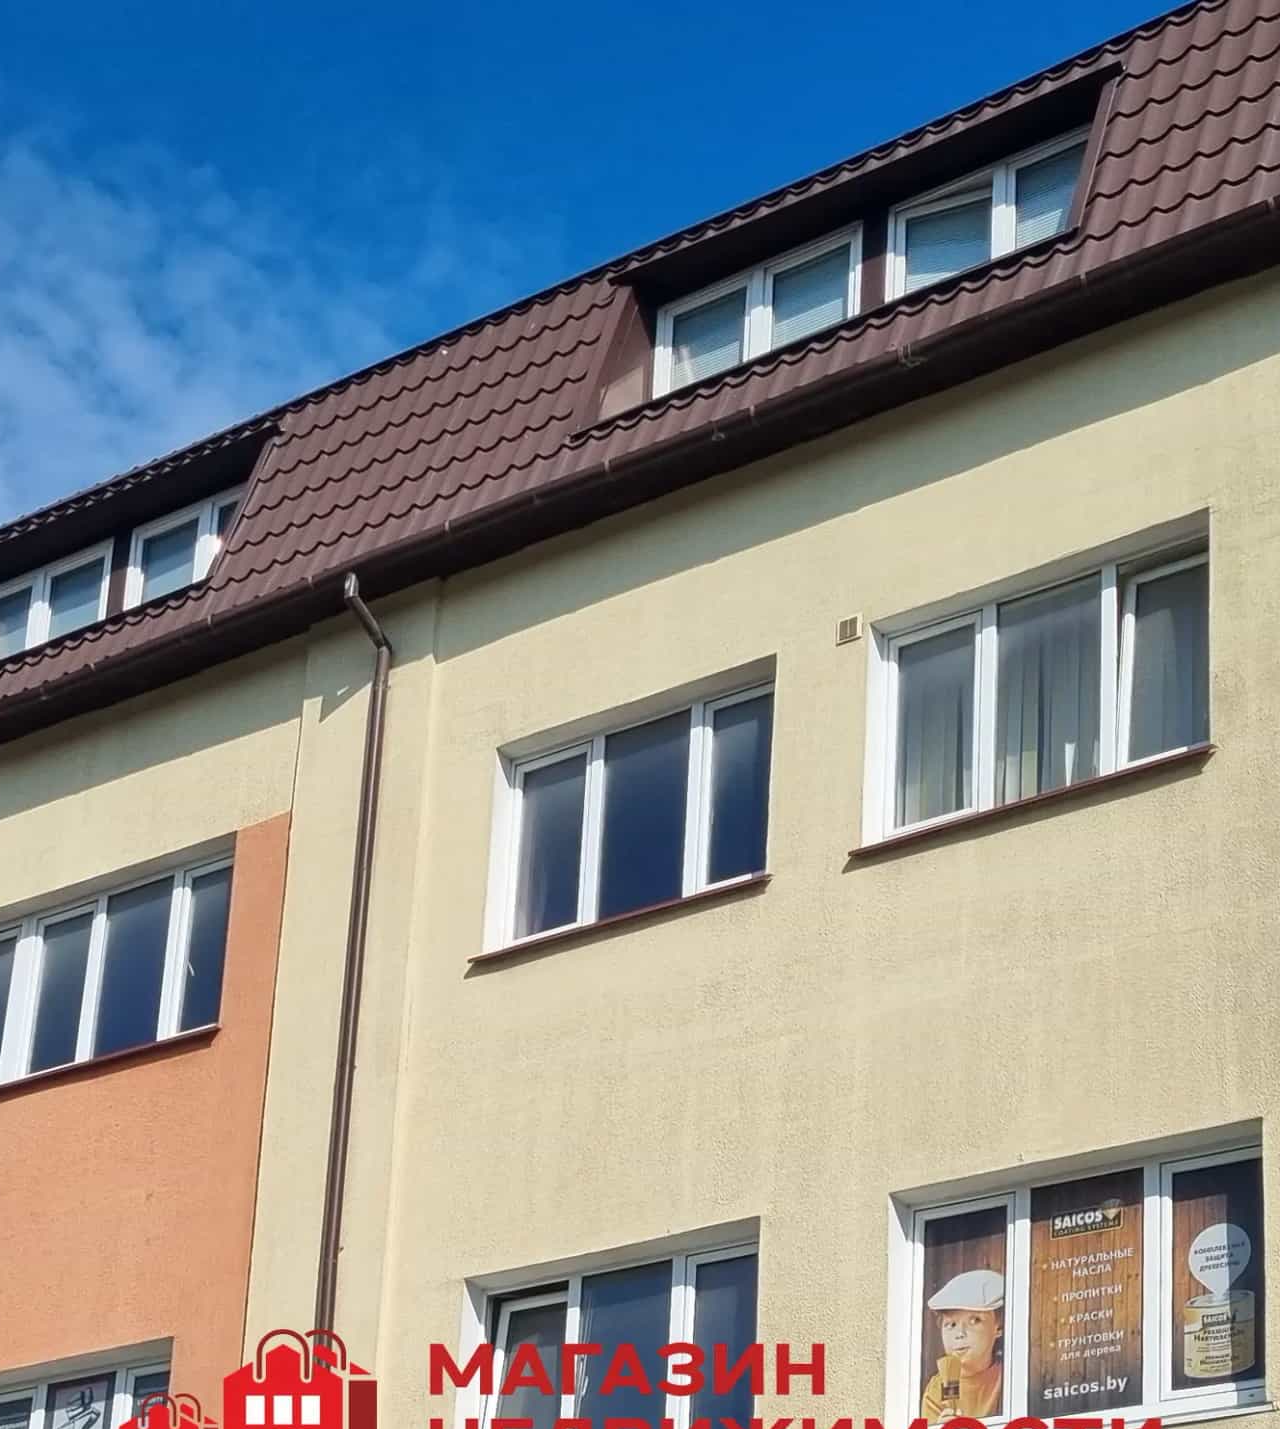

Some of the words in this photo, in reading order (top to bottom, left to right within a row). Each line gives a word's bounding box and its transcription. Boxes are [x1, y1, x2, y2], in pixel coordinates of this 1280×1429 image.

[1054, 1208, 1104, 1230] SAICOS
[1051, 1247, 1135, 1270] НАТУРАЛЬНЫЕ
[1061, 1284, 1122, 1303] ПРОПИТКИ
[1069, 1307, 1113, 1324] КРАСКИ
[1058, 1329, 1124, 1349] ГРУНТОВКИ
[1060, 1350, 1081, 1361] для
[1083, 1344, 1121, 1359] дерева
[1043, 1375, 1129, 1400] saicos.by
